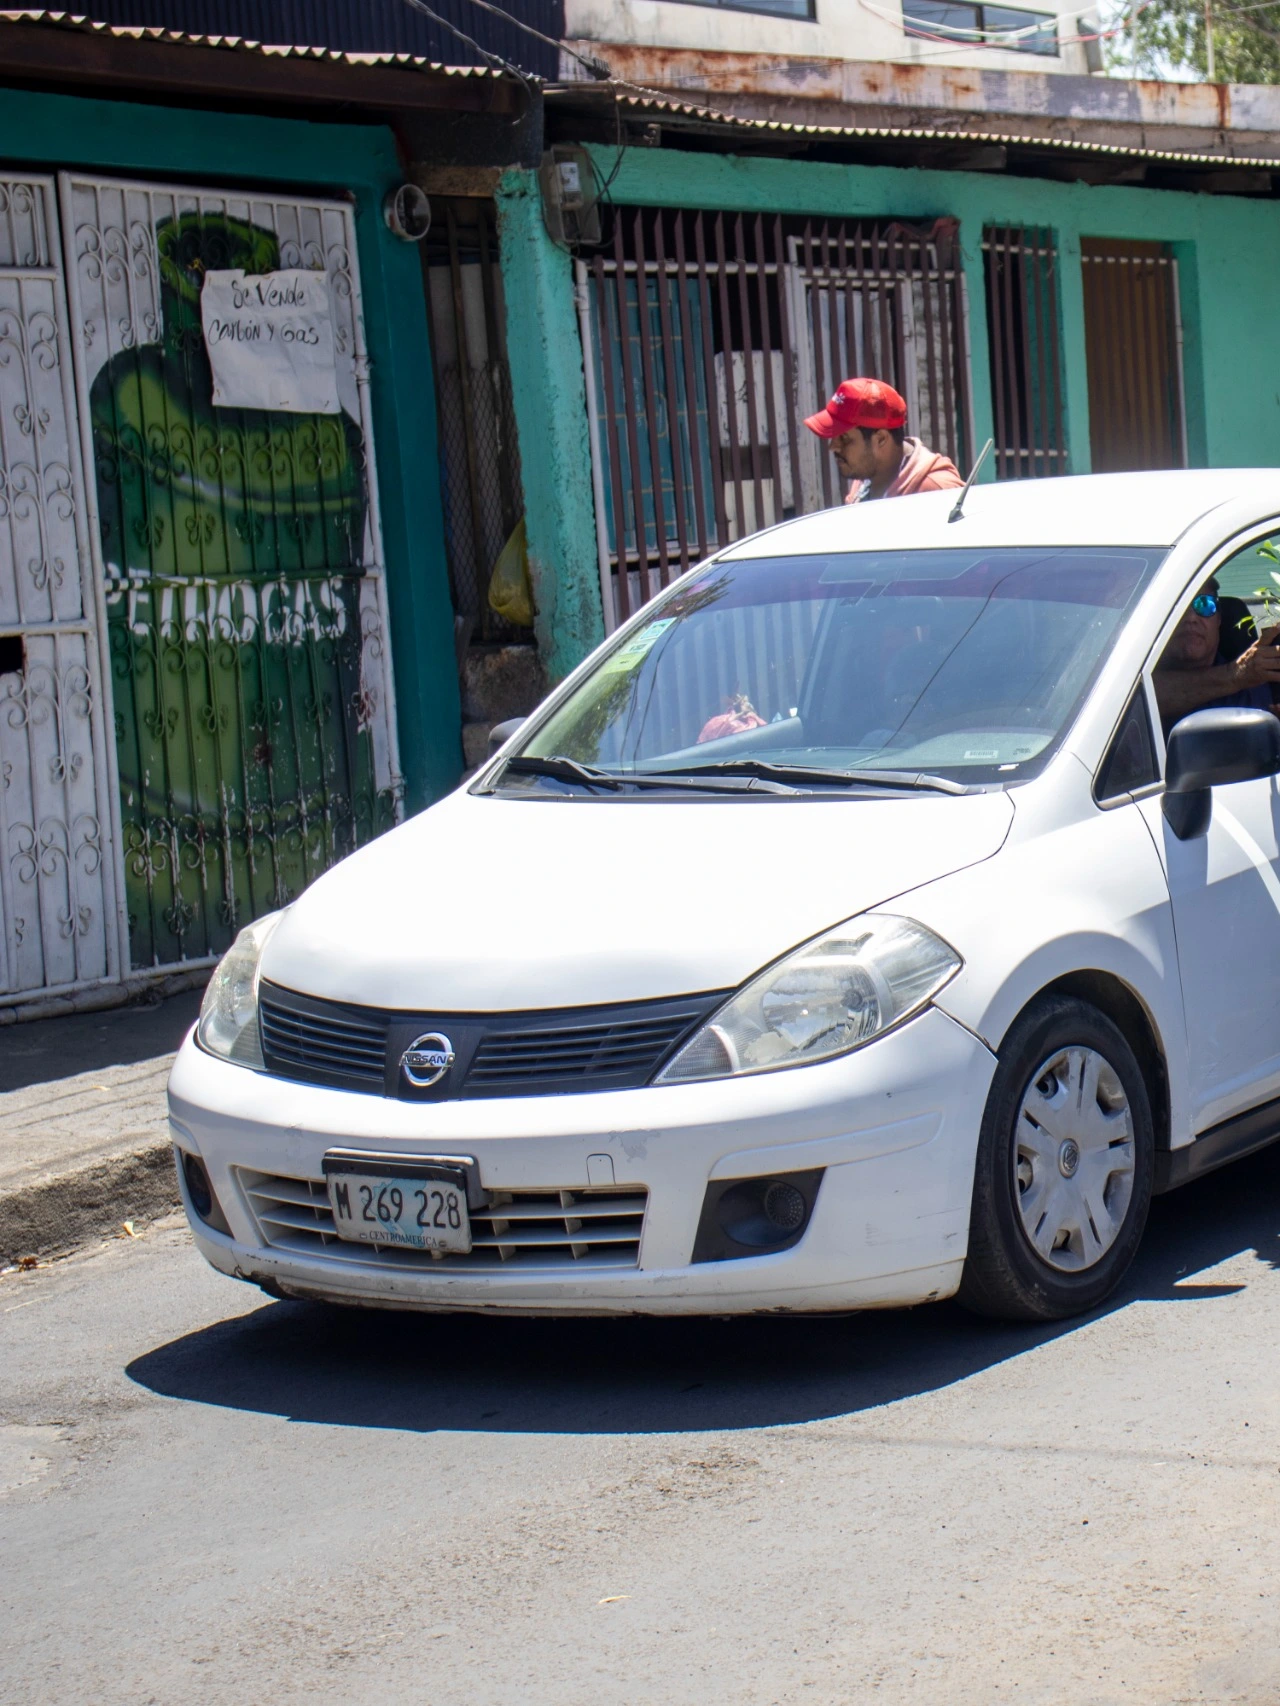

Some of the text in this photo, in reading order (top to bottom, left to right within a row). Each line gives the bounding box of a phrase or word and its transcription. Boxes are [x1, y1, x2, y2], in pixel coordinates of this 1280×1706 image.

[231, 280, 253, 309] Se
[279, 322, 319, 345] Gas
[405, 1055, 447, 1064] NISSAN
[335, 1182, 461, 1229] M 269 228
[369, 1230, 437, 1247] CENTROAMERICA
